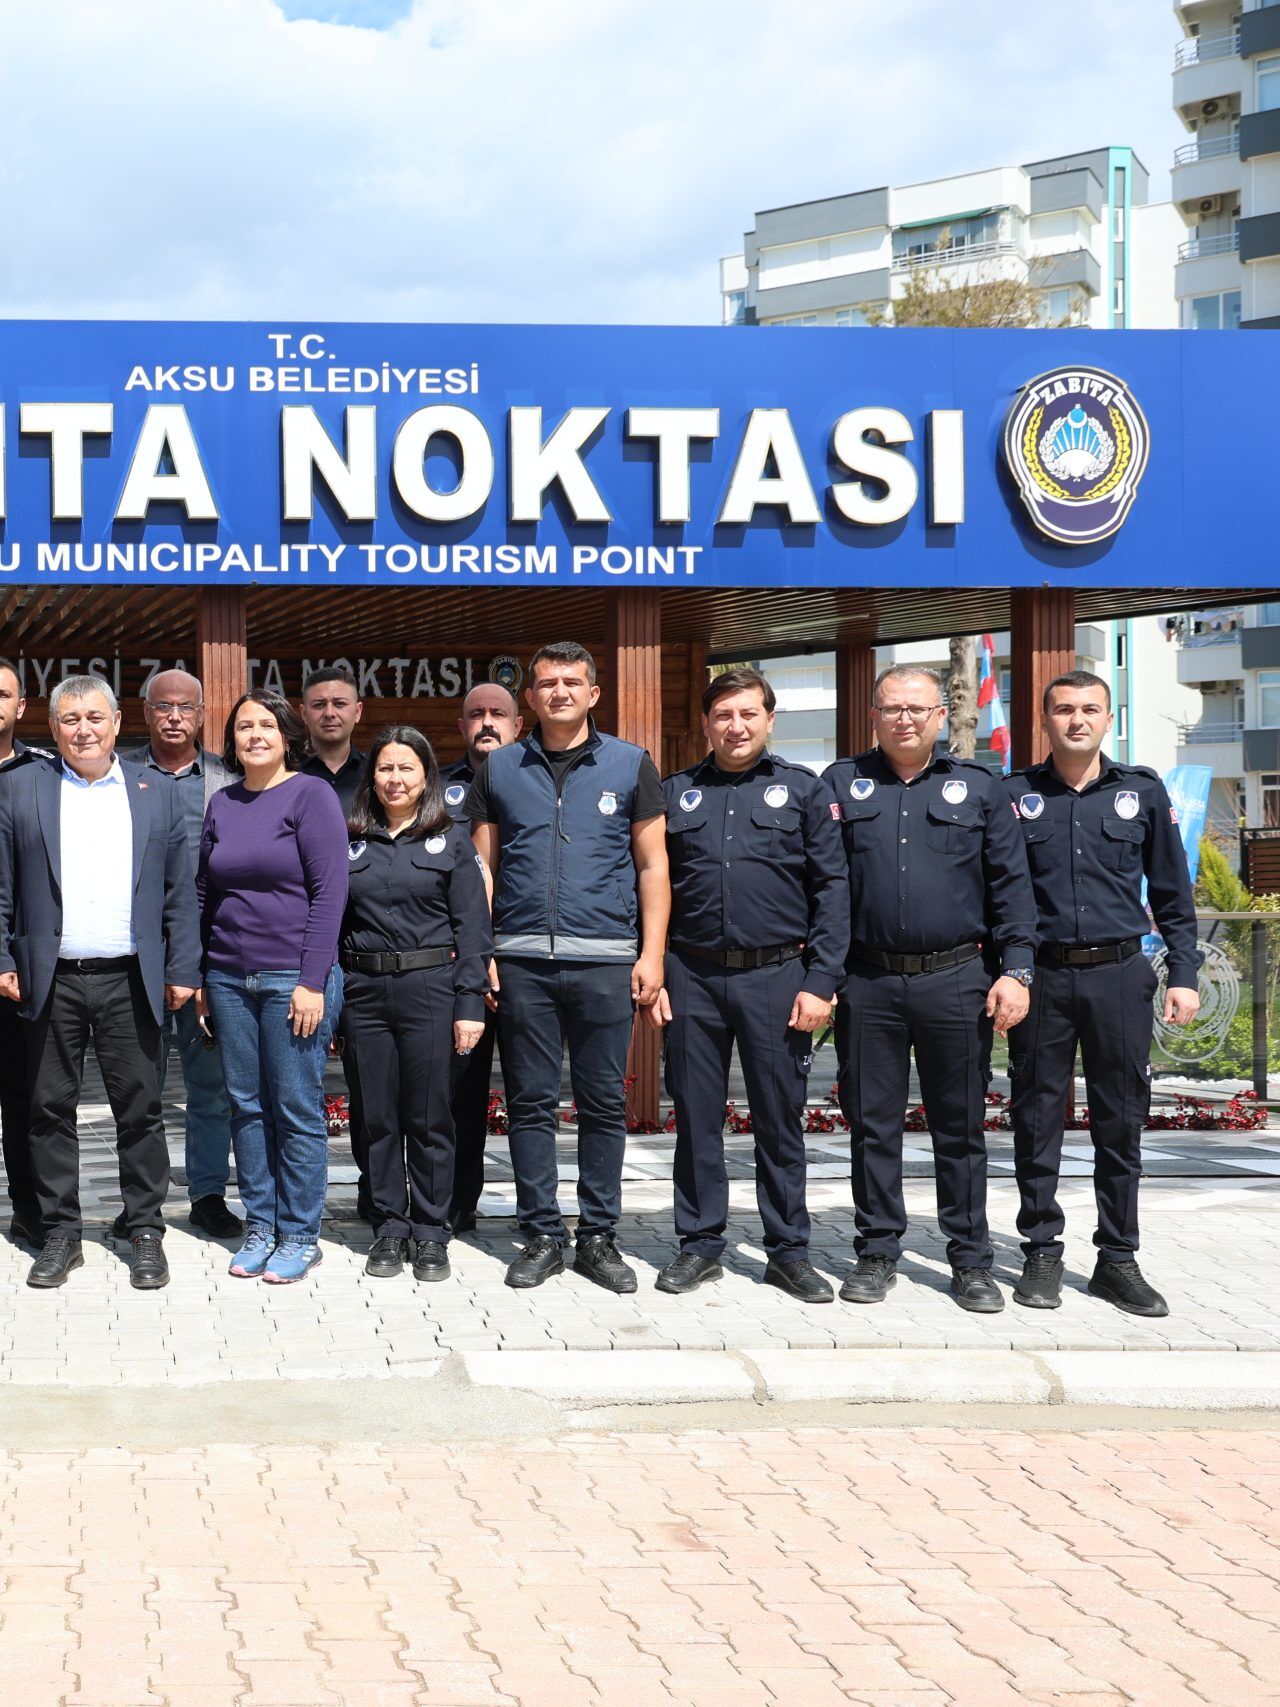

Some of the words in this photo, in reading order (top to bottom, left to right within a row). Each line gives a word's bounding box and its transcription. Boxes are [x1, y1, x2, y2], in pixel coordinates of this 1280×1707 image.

[268, 333, 336, 360] T.C.
[123, 365, 235, 393] AKSU
[248, 361, 479, 394] BELEDİYESİ
[1039, 377, 1114, 407] ZABITA
[280, 402, 965, 526] NOKTASI
[37, 542, 347, 573] MUNICIPALITY
[359, 544, 557, 574] TOURISM
[572, 546, 704, 575] POINT
